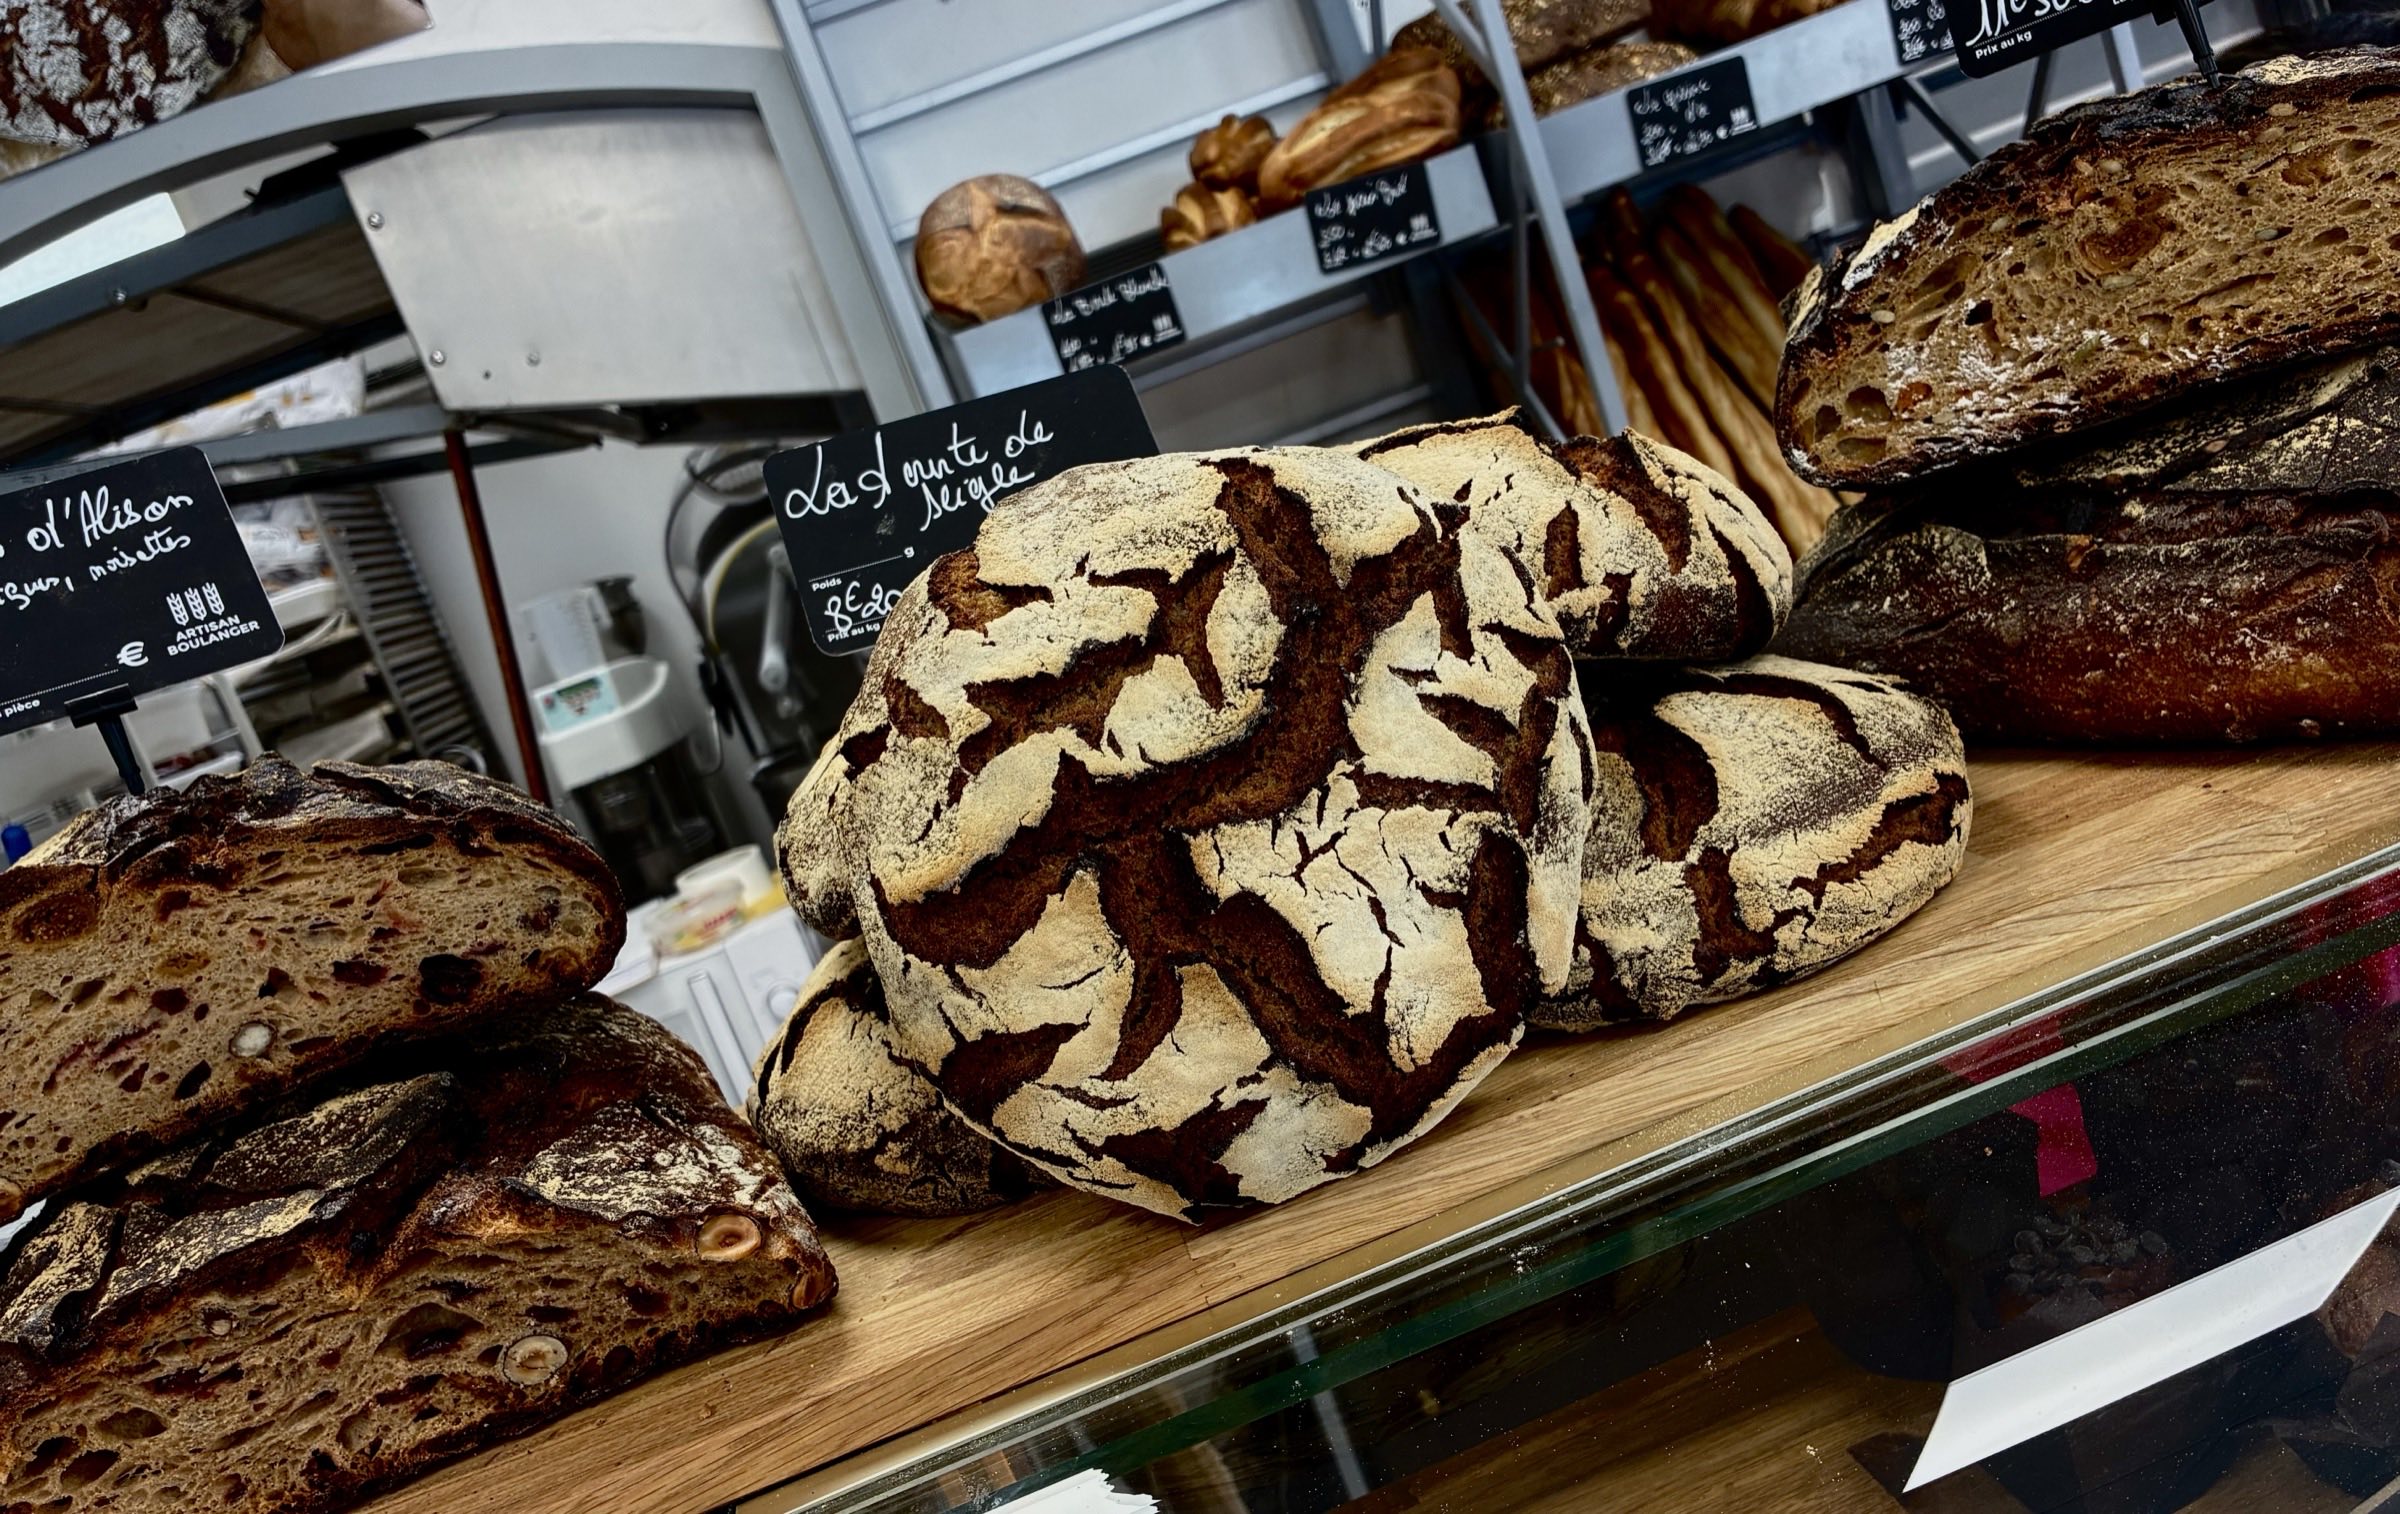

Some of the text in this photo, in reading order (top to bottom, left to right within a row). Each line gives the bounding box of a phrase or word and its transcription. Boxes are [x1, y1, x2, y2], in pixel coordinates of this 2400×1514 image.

[1975, 30, 2033, 59] Prix au kg
[1005, 409, 1054, 458] de
[903, 546, 915, 558] g
[812, 578, 842, 592] Poids
[167, 620, 260, 656] BOULANGER
[176, 614, 240, 642] ARTISAN
[827, 622, 881, 643] Prix au kg
[116, 641, 149, 668] €
